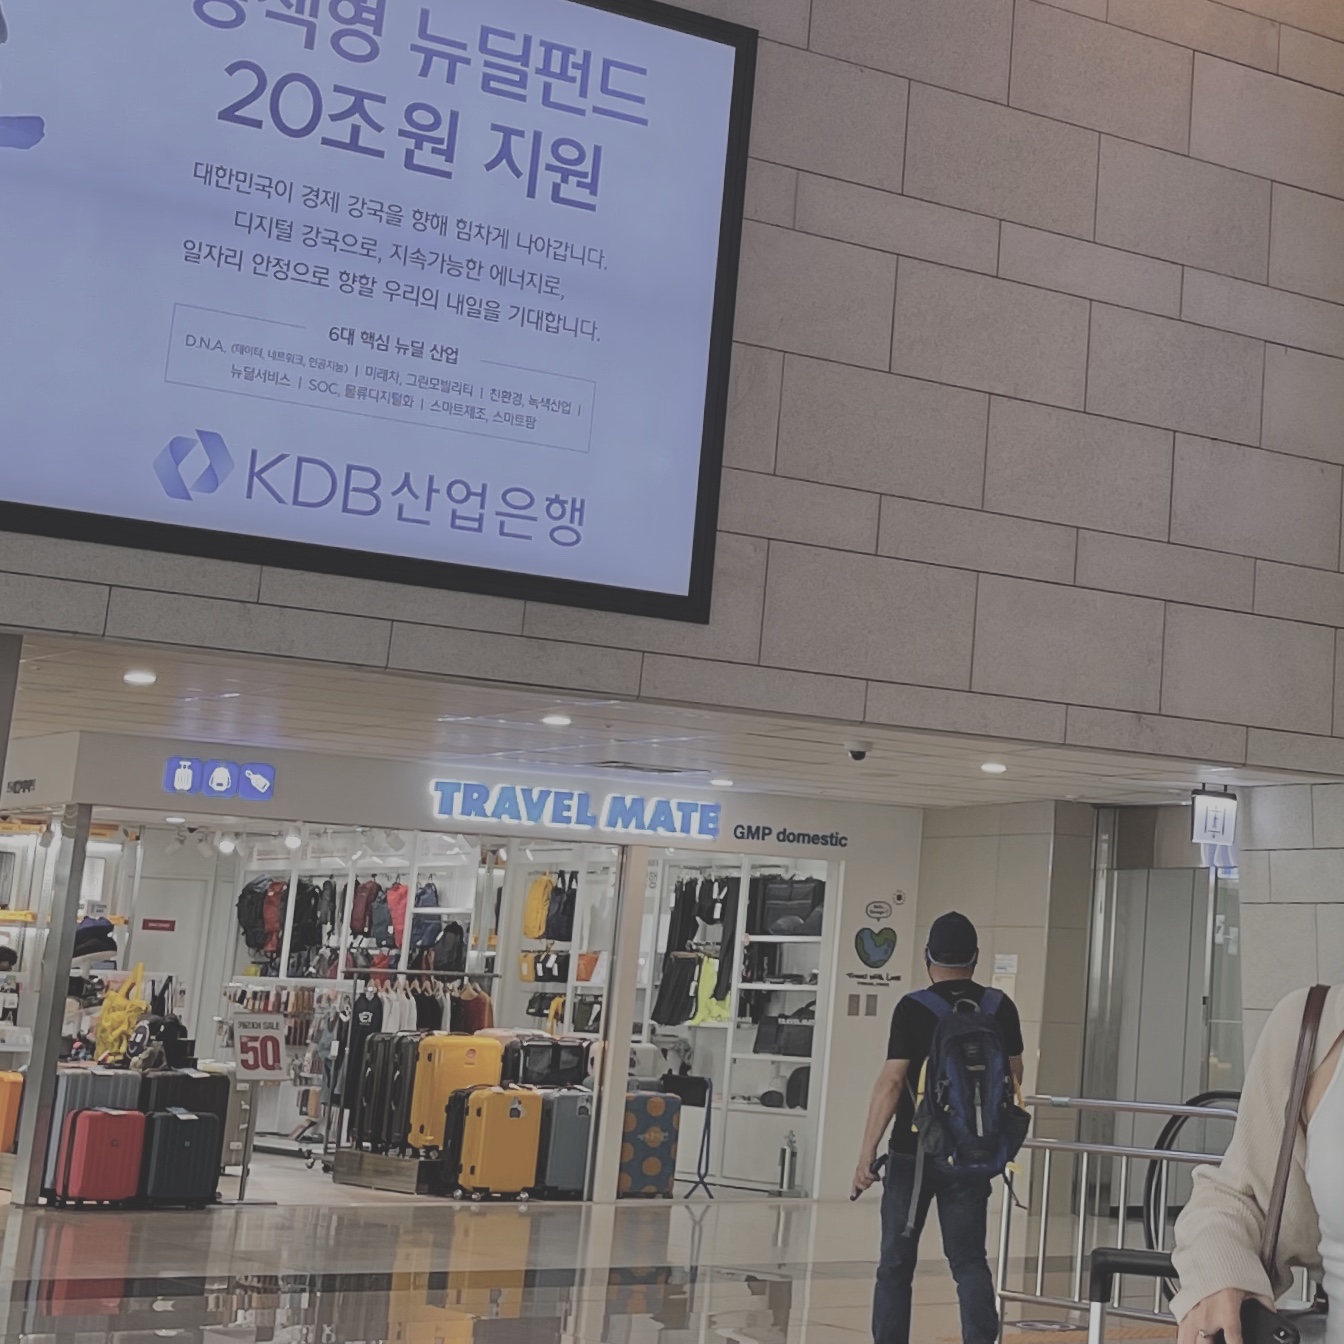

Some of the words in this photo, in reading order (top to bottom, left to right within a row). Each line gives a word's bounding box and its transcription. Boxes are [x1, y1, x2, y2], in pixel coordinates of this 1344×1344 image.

[409, 8, 649, 126] 뉴딜펀드
[218, 60, 459, 179] 20조원
[484, 123, 602, 212] 지원
[193, 162, 293, 203] 대한민국이
[302, 185, 340, 213] 경제
[348, 195, 404, 227] 강국을
[412, 209, 447, 236] 향해
[456, 218, 509, 249] 힘차게
[517, 232, 607, 270] 나아갑니다.
[234, 211, 293, 242] 디지털
[302, 225, 382, 263] 강국으로,
[390, 243, 484, 281] 지속가능한
[490, 264, 564, 300] 에너지로,
[183, 239, 243, 271] 일자리
[252, 253, 329, 287] 안정으로
[339, 270, 377, 298] 향할
[383, 280, 439, 310] 우리의
[447, 293, 501, 322] 내일을
[508, 305, 600, 342] 기대합니다.
[231, 364, 291, 387] 뉴딜서비스
[329, 326, 355, 346] 6대
[360, 330, 390, 352] 핵심
[395, 337, 424, 358] 뉴딜
[430, 343, 459, 365] 산업
[406, 373, 473, 397] 그린모빌리티
[245, 448, 587, 547] KDB산업은행
[434, 781, 598, 830] TRAVEL
[607, 795, 721, 839] MATE
[733, 824, 772, 843] GMP
[776, 828, 849, 849] domestic
